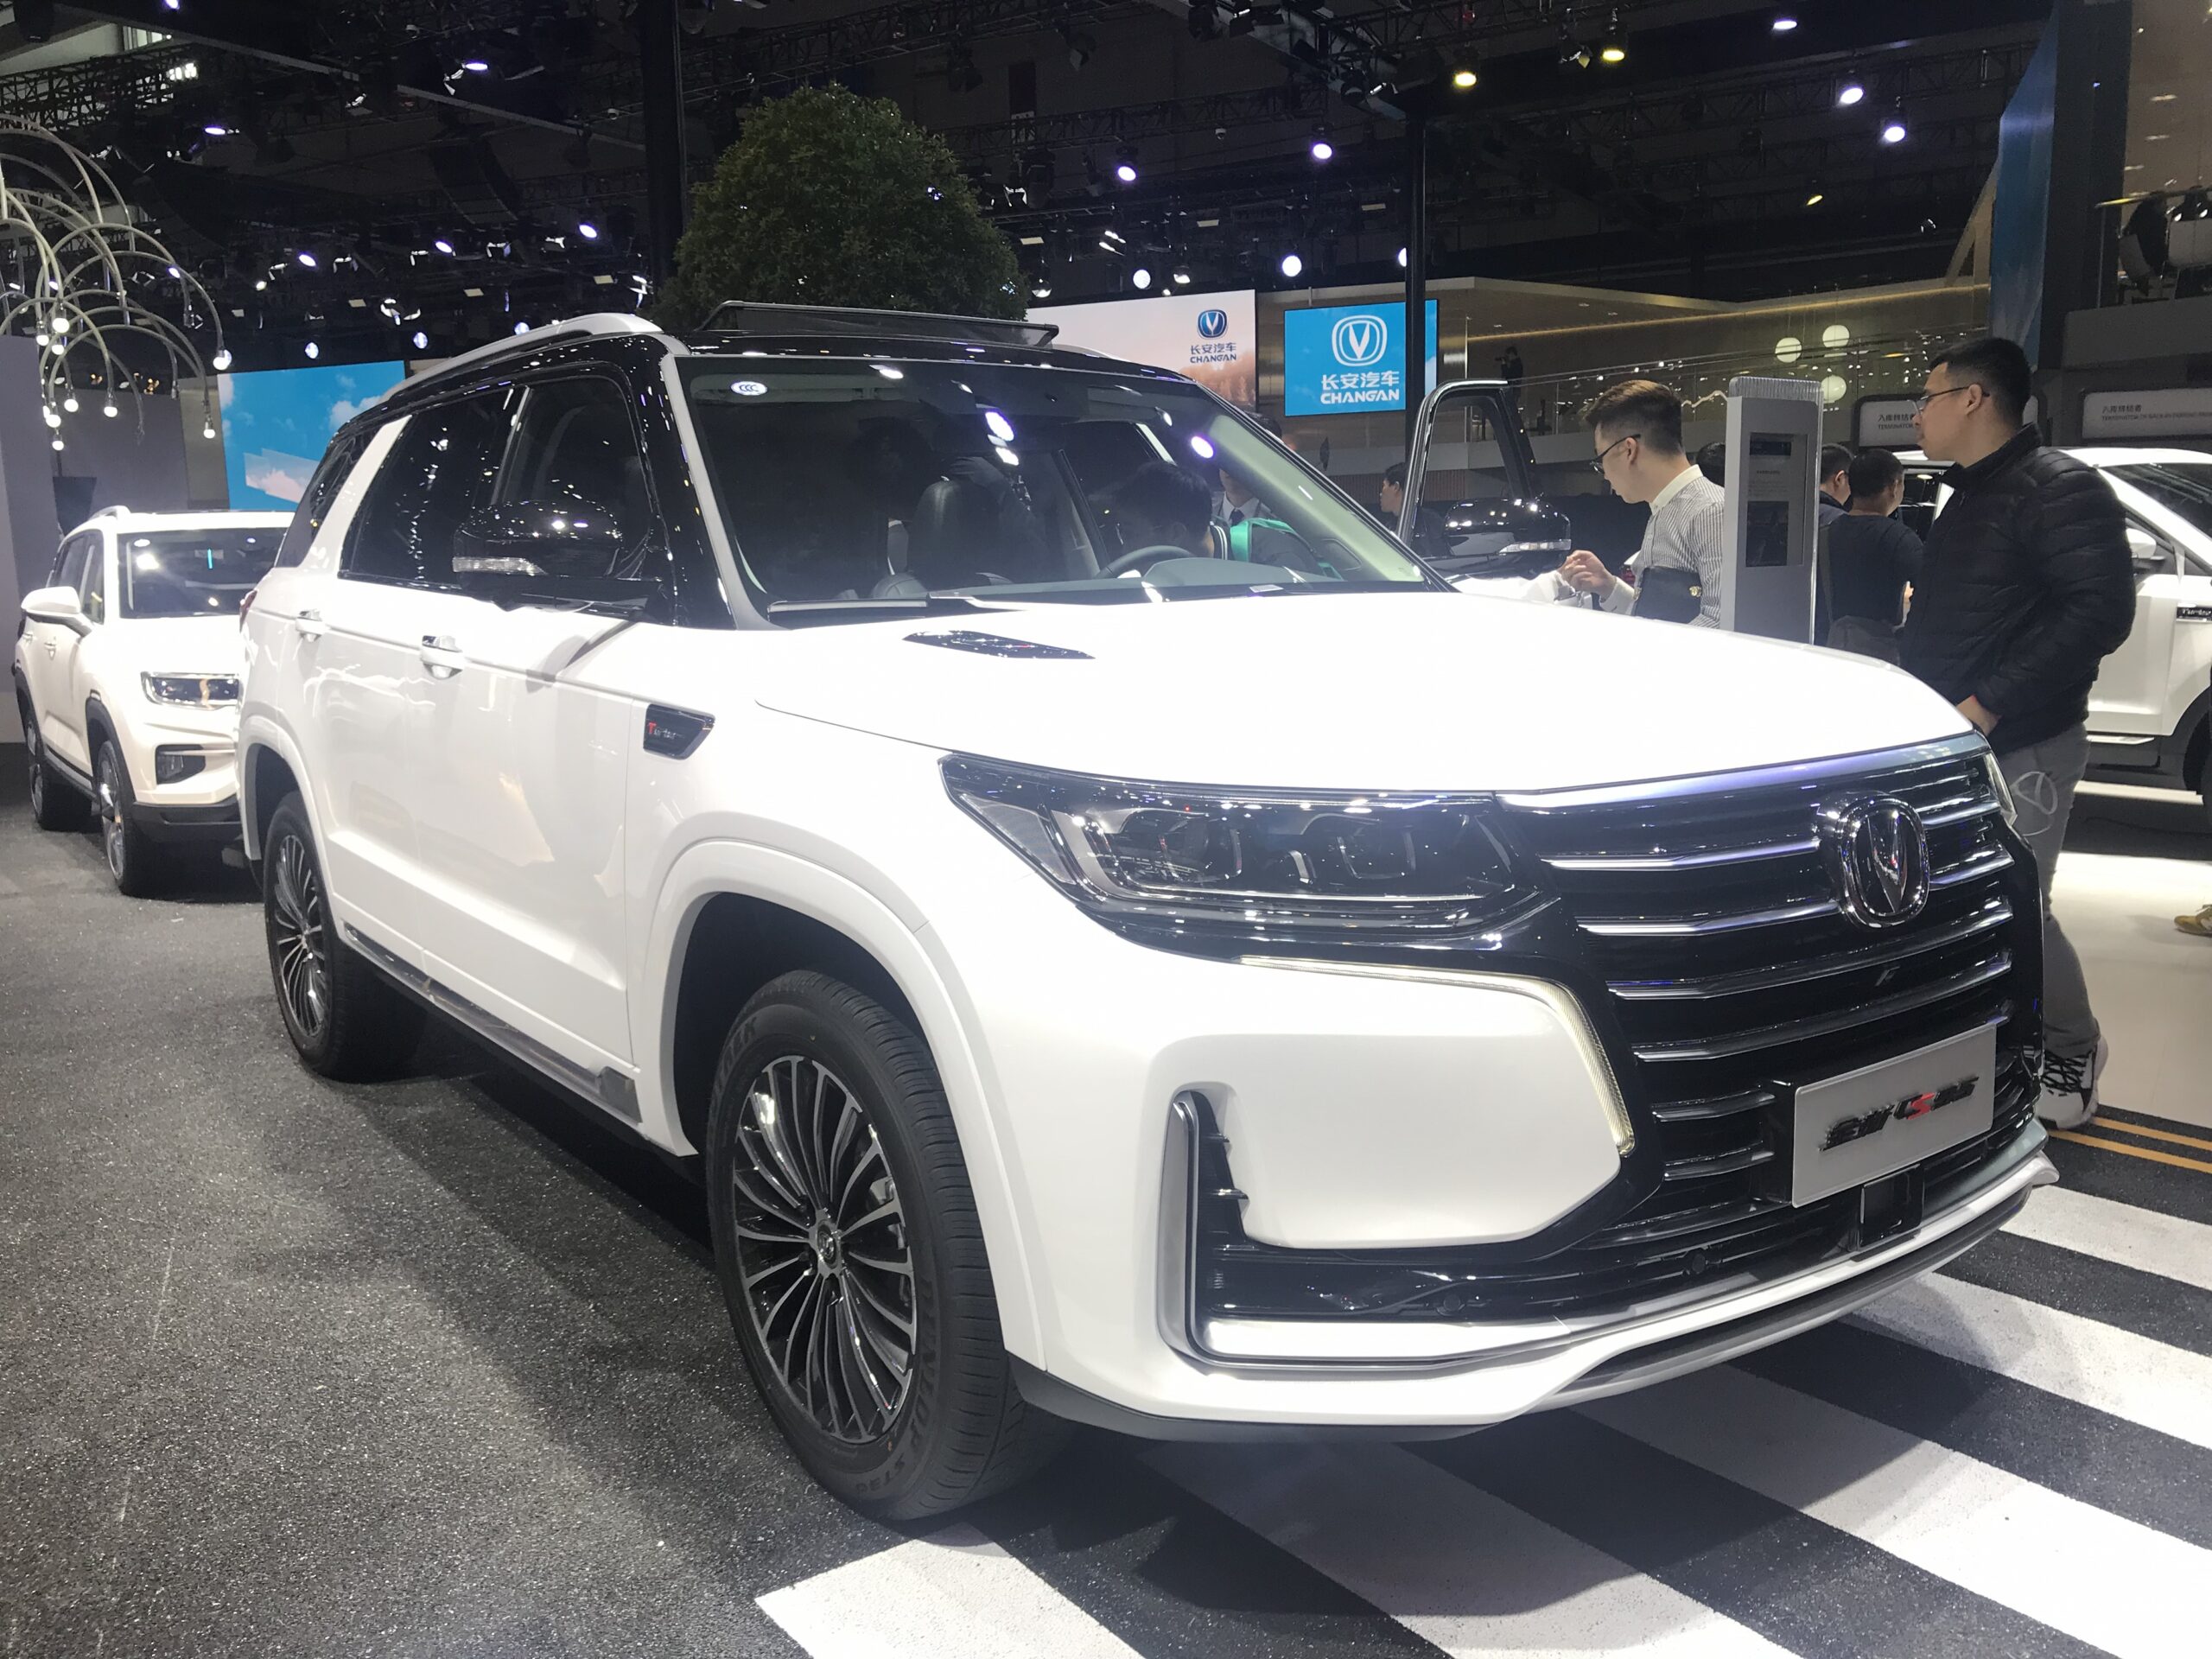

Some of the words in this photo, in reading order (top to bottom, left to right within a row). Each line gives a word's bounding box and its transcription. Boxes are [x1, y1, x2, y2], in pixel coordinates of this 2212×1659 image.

[1191, 342, 1236, 354] 长安汽车
[1190, 354, 1236, 364] CHANGAN
[1321, 370, 1400, 391] 长安汽车
[739, 384, 760, 392] CCC
[1320, 389, 1400, 404] CHANGAN
